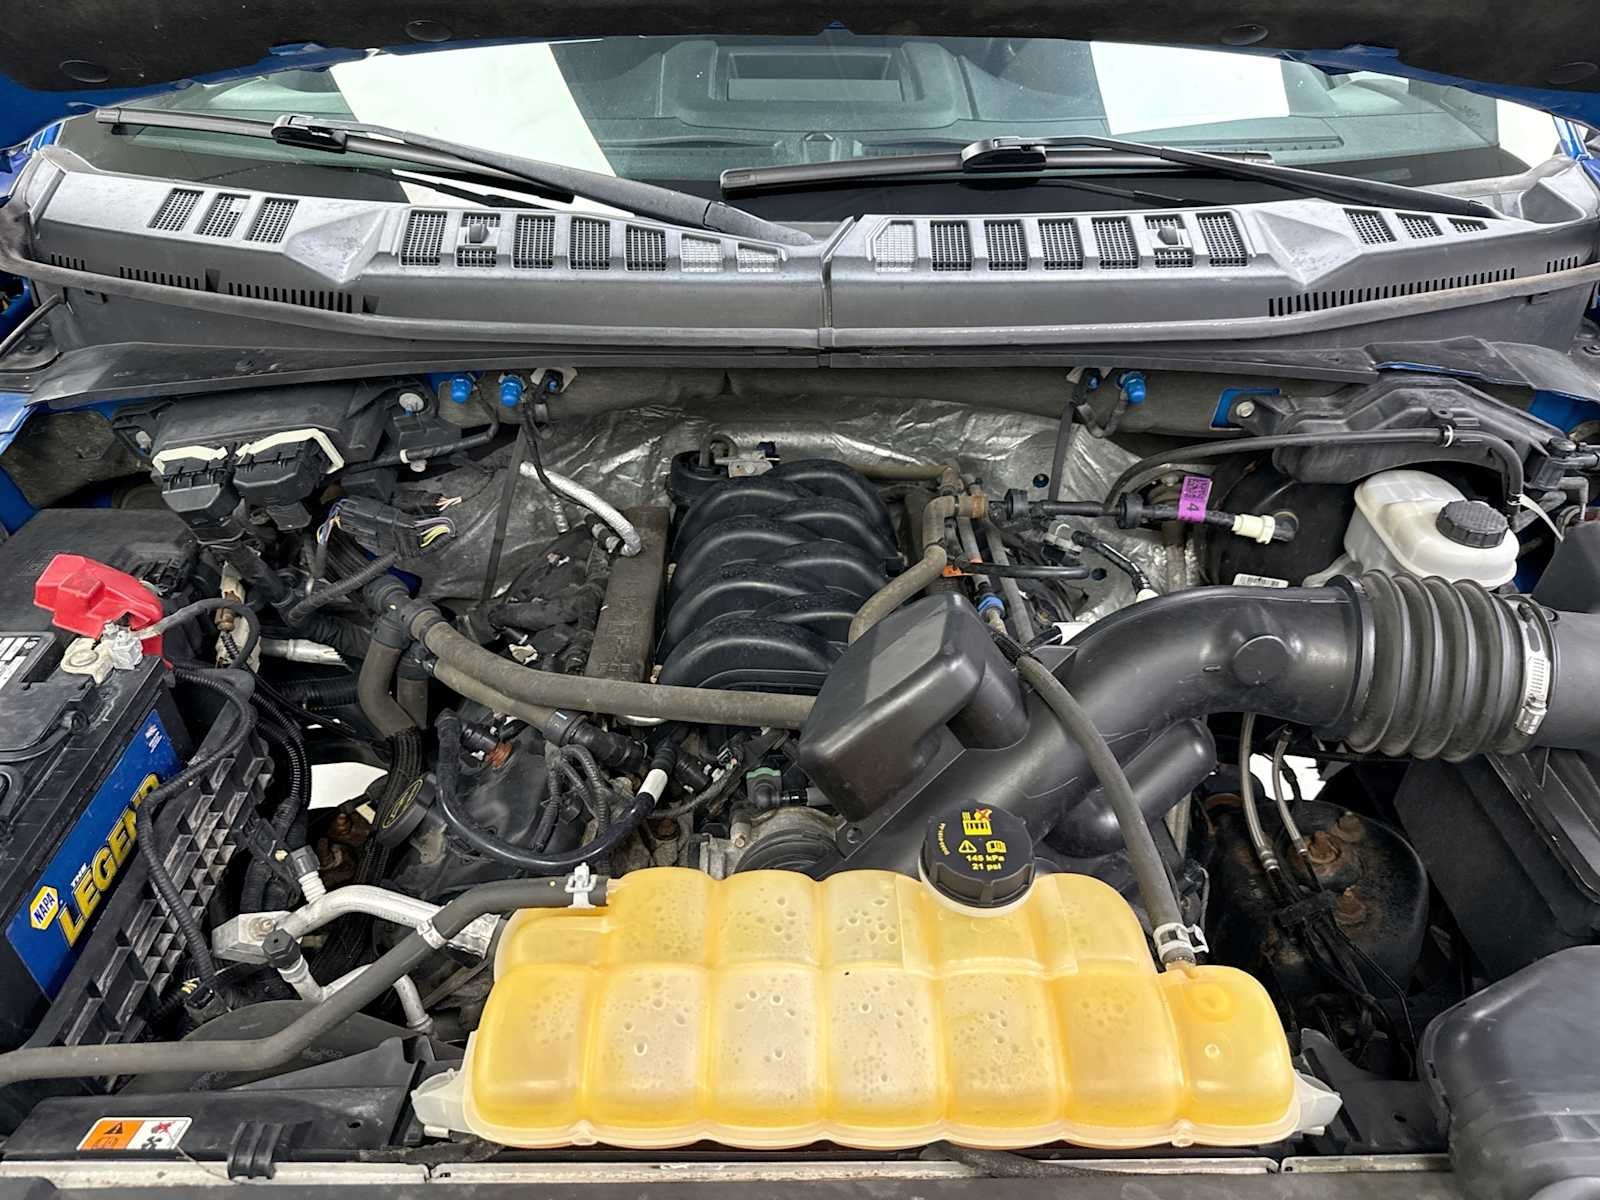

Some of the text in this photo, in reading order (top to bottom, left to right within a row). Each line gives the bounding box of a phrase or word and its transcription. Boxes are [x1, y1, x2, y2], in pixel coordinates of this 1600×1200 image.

[1187, 503, 1200, 511] 4
[985, 854, 1006, 862] kPa
[971, 863, 1002, 872] 21 psi
[33, 892, 56, 924] NAPA
